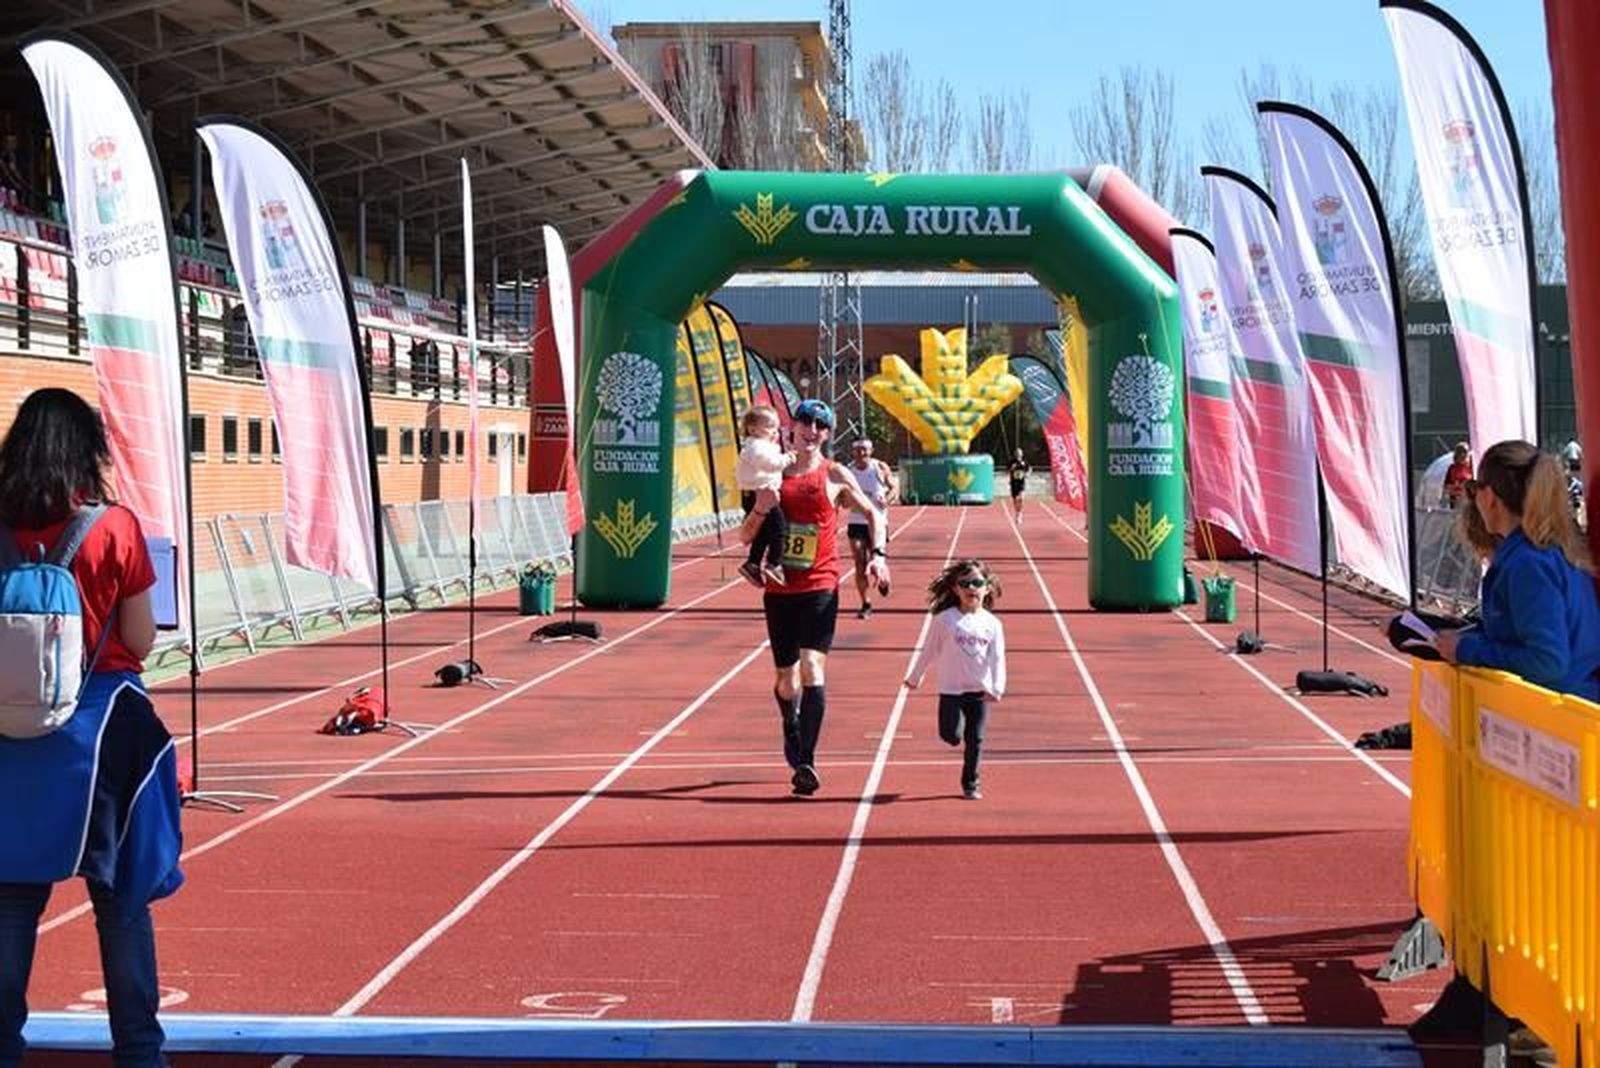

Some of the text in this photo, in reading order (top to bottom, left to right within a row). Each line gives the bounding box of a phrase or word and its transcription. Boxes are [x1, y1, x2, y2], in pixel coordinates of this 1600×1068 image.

[805, 204, 1031, 236] CAJA RURAL
[593, 461, 660, 473] CAJA RURAL
[1108, 464, 1174, 476] CAJA RURAL
